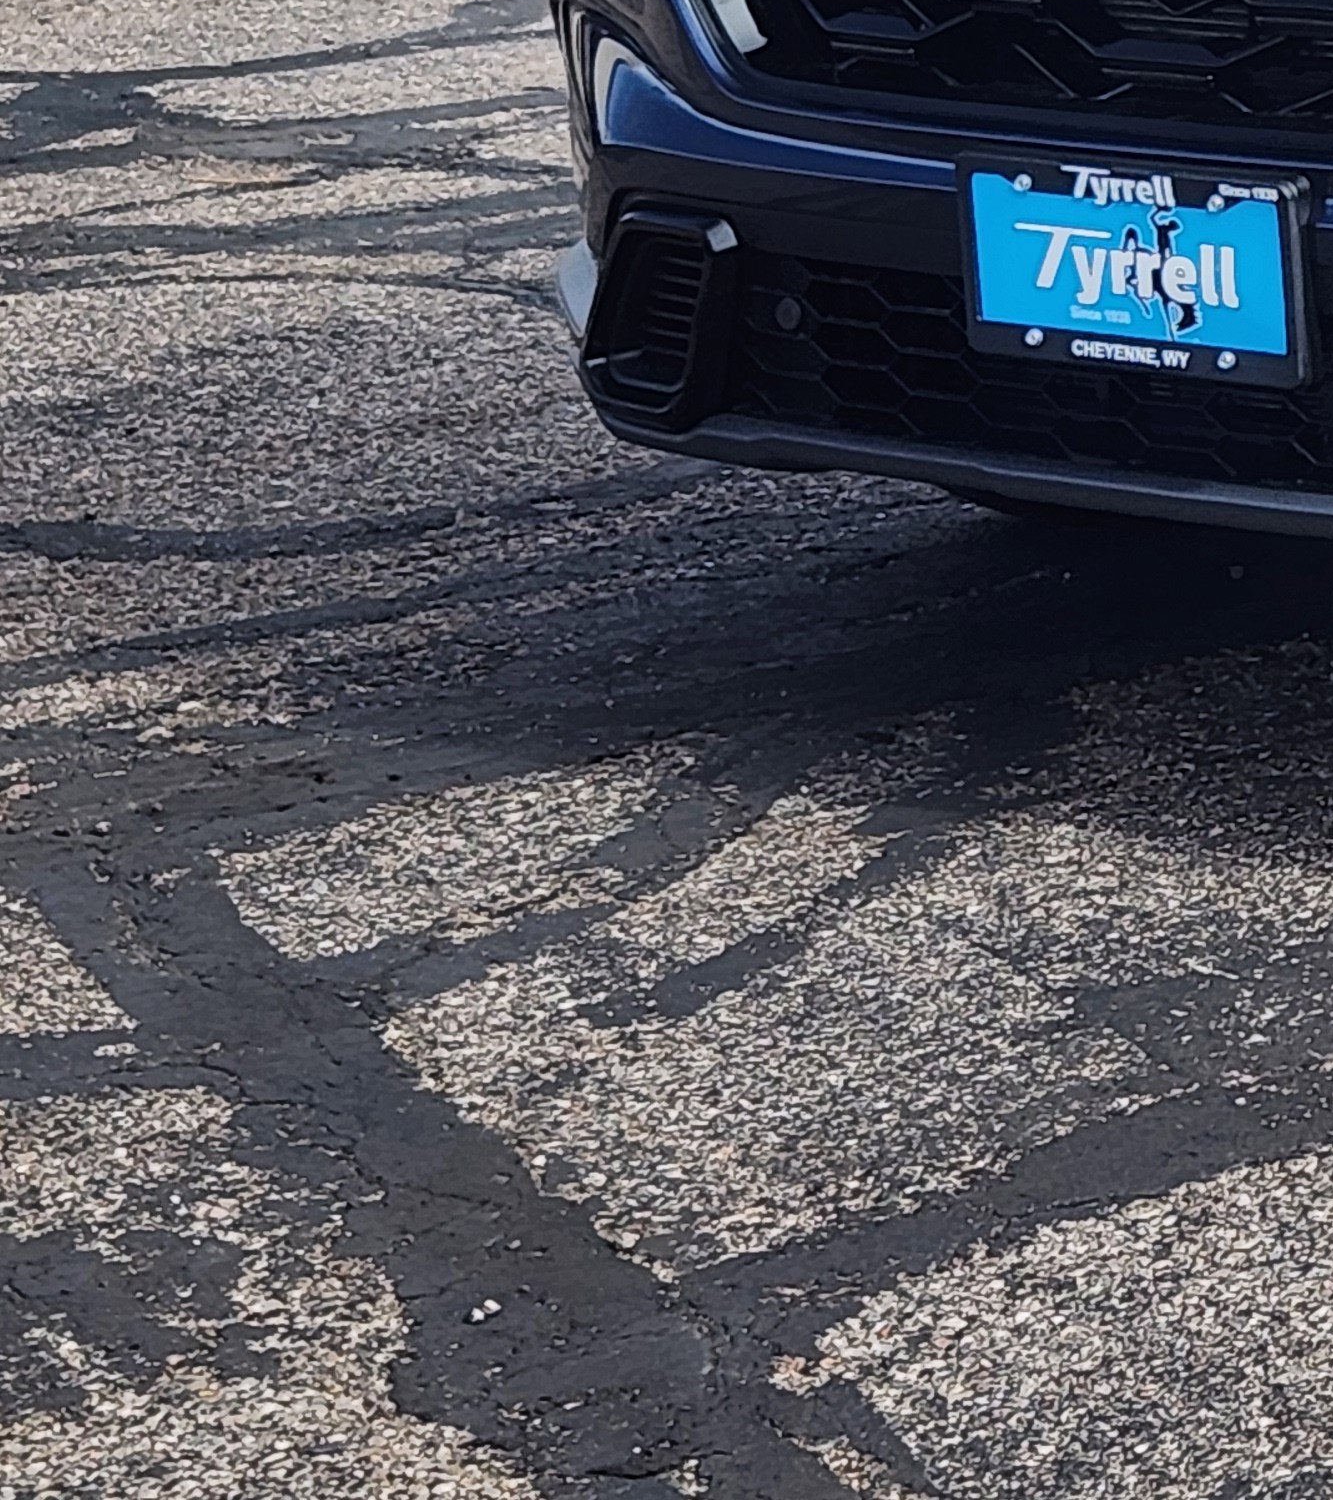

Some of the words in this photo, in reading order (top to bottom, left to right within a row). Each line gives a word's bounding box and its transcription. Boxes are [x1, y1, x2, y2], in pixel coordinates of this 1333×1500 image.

[1060, 165, 1176, 207] Tyrrell
[1014, 222, 1239, 308] Tyrrell
[1071, 338, 1161, 368] CHEYENNE,
[1161, 349, 1191, 370] WY
